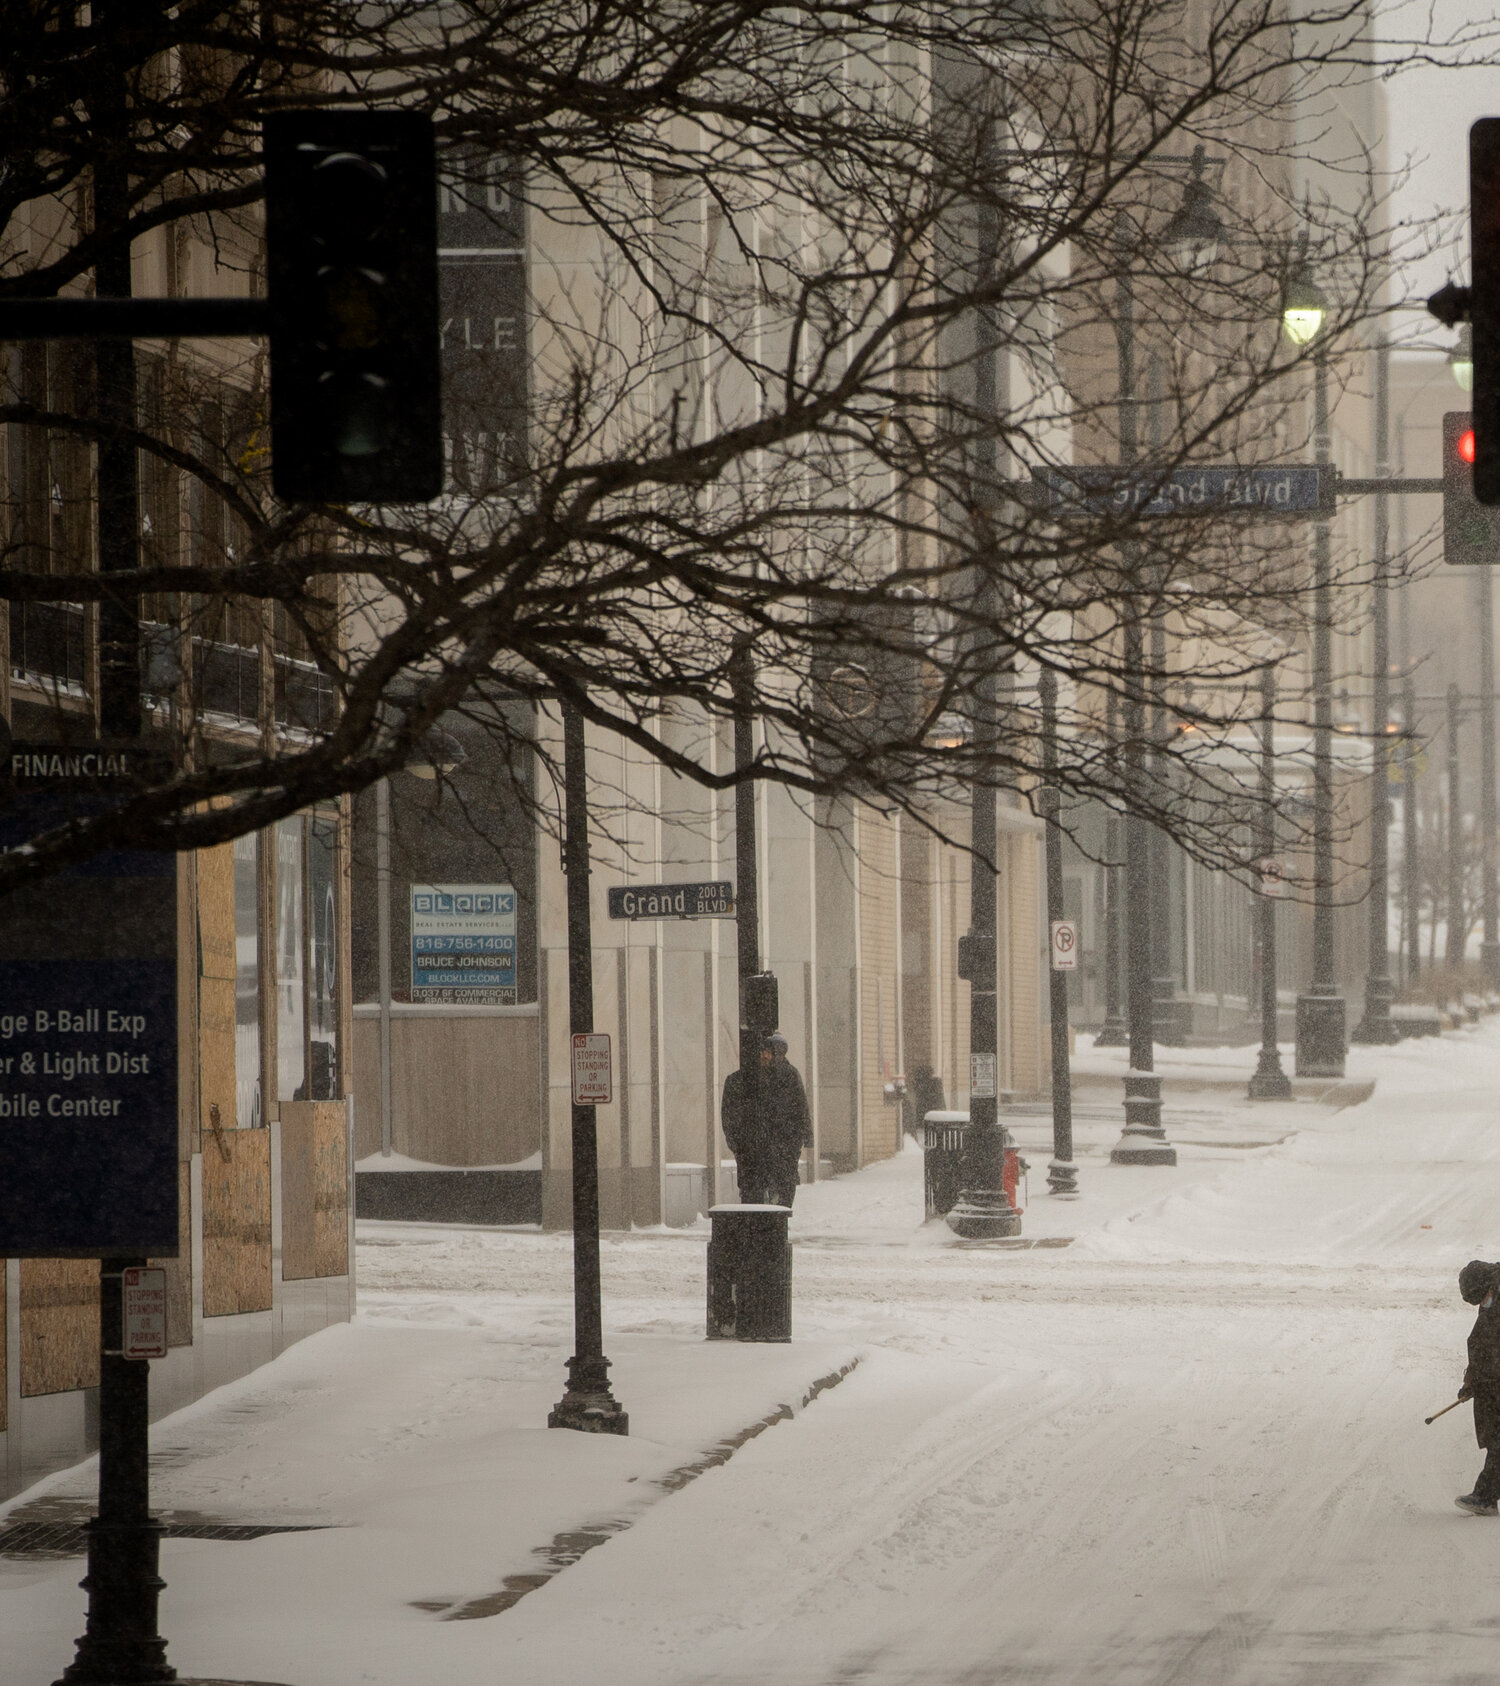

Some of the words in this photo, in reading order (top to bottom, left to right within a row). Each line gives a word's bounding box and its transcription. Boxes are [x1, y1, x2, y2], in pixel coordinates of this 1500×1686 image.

[12, 753, 131, 777] FINANCIAL
[698, 886, 717, 899] 200
[719, 885, 725, 898] E
[415, 896, 512, 911] BLOCK
[623, 890, 685, 915] Grand
[697, 900, 727, 913] BLVD
[416, 938, 513, 949] 816-756-1400
[417, 957, 454, 967] BRUCE
[457, 957, 511, 967] JOHNSON
[428, 974, 500, 983] BLOCKLLC.COM
[414, 990, 439, 998] 3,037
[1, 1015, 28, 1039] ge
[35, 1009, 99, 1033] B-Ball
[106, 1010, 146, 1039] Exp
[575, 1037, 586, 1047] NO
[576, 1050, 608, 1060] STOPPING
[0, 1057, 14, 1074] r
[20, 1052, 36, 1074] &
[43, 1051, 100, 1081] Light
[106, 1052, 150, 1074] Dist
[577, 1061, 608, 1071] STANDING
[588, 1072, 598, 1082] OR
[579, 1083, 607, 1092] PARKING
[47, 1094, 122, 1117] Center
[128, 1289, 163, 1301] STOPPING
[128, 1303, 163, 1315] STANDING
[130, 1332, 161, 1344] PARKING
